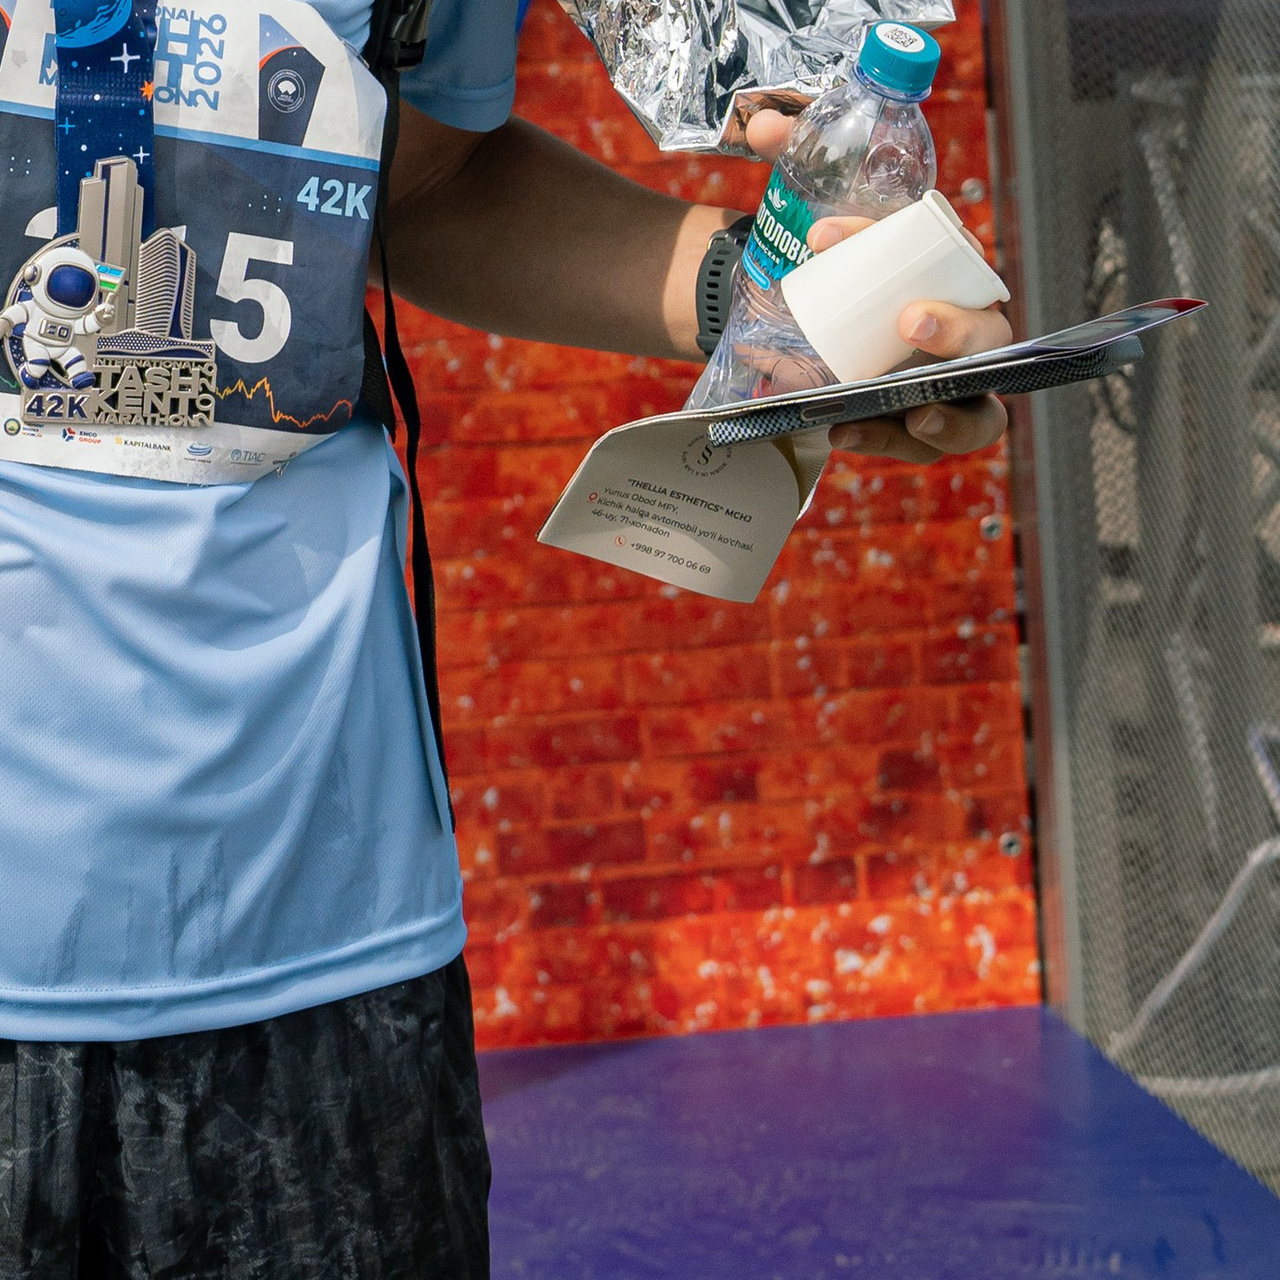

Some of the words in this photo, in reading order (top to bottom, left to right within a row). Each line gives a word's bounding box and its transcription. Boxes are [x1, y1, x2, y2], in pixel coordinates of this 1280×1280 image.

[193, 13, 227, 111] 2026
[296, 175, 370, 220] 42K
[93, 365, 201, 395] TASH
[26, 393, 90, 419] 42K
[92, 389, 197, 416] KENT
[92, 412, 200, 427] MARATHON
[79, 430, 98, 438] ENCO
[79, 436, 101, 444] GROUP
[123, 439, 172, 452] KAPITALBANK
[243, 451, 266, 462] TIAC
[604, 487, 629, 501] Yunus
[631, 491, 656, 506] Obod
[597, 497, 623, 511] Kichik
[625, 503, 650, 519] halqa
[652, 514, 698, 533] avtomobil
[620, 515, 670, 538] 71-xonadon
[725, 507, 752, 523] MCHJ
[630, 542, 653, 555] +998
[654, 548, 667, 559] 97
[668, 553, 685, 565] 700
[685, 559, 699, 570] 06
[699, 563, 712, 575] 69
